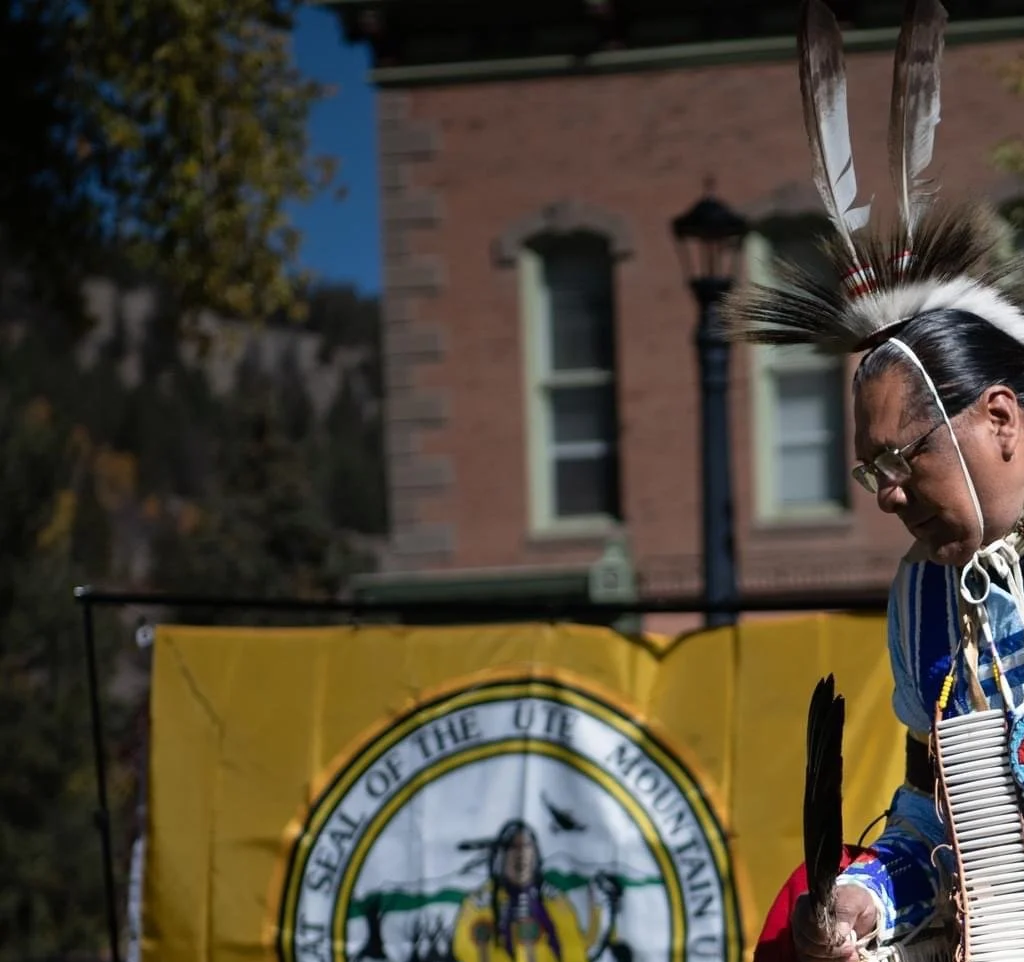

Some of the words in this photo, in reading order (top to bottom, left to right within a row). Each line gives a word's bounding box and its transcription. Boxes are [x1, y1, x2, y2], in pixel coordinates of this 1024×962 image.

[307, 812, 366, 896] SEAL
[364, 752, 404, 801] OF
[413, 709, 484, 761] THE
[511, 701, 580, 745] UTE
[606, 742, 719, 918] MOUNTAIN
